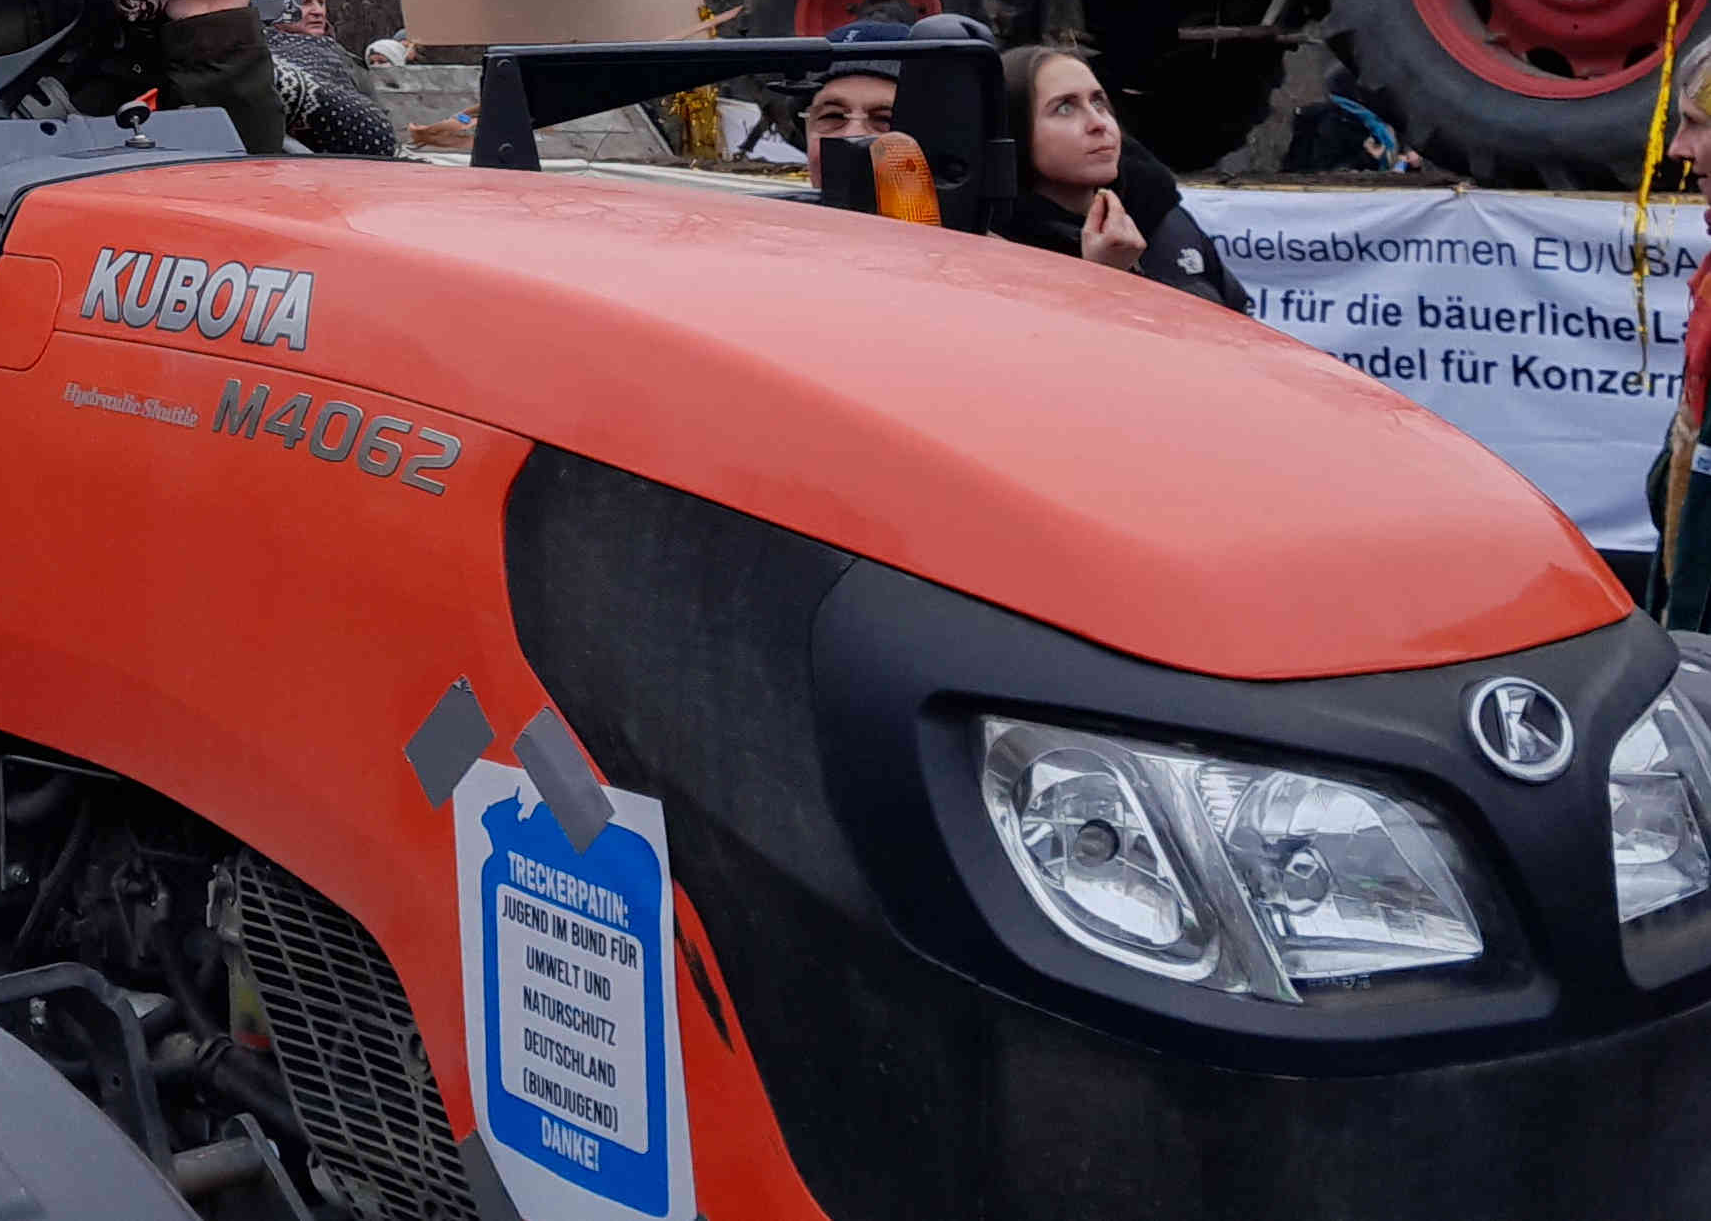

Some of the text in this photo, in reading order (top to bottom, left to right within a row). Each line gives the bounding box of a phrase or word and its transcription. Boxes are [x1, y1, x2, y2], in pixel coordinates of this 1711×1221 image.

[1532, 236, 1699, 278] EU/USA
[80, 246, 315, 352] KUBOTA
[1280, 289, 1336, 324] für
[1346, 292, 1404, 327] die
[1417, 294, 1636, 343] bäuerliche
[1326, 345, 1428, 383] ndel
[1441, 349, 1499, 386] für
[211, 378, 462, 497] M4062
[506, 849, 630, 930] TRECKERPATIN:
[501, 894, 638, 971] JUGEND IM BUND FÜR
[525, 945, 611, 1001] UMWELT UND
[522, 984, 618, 1047] NATURSCHUTZ
[522, 1027, 617, 1089] DEUTSCHLAND
[522, 1066, 619, 1134] (BUNDJUGEND)
[540, 1114, 600, 1172] DANKE!
